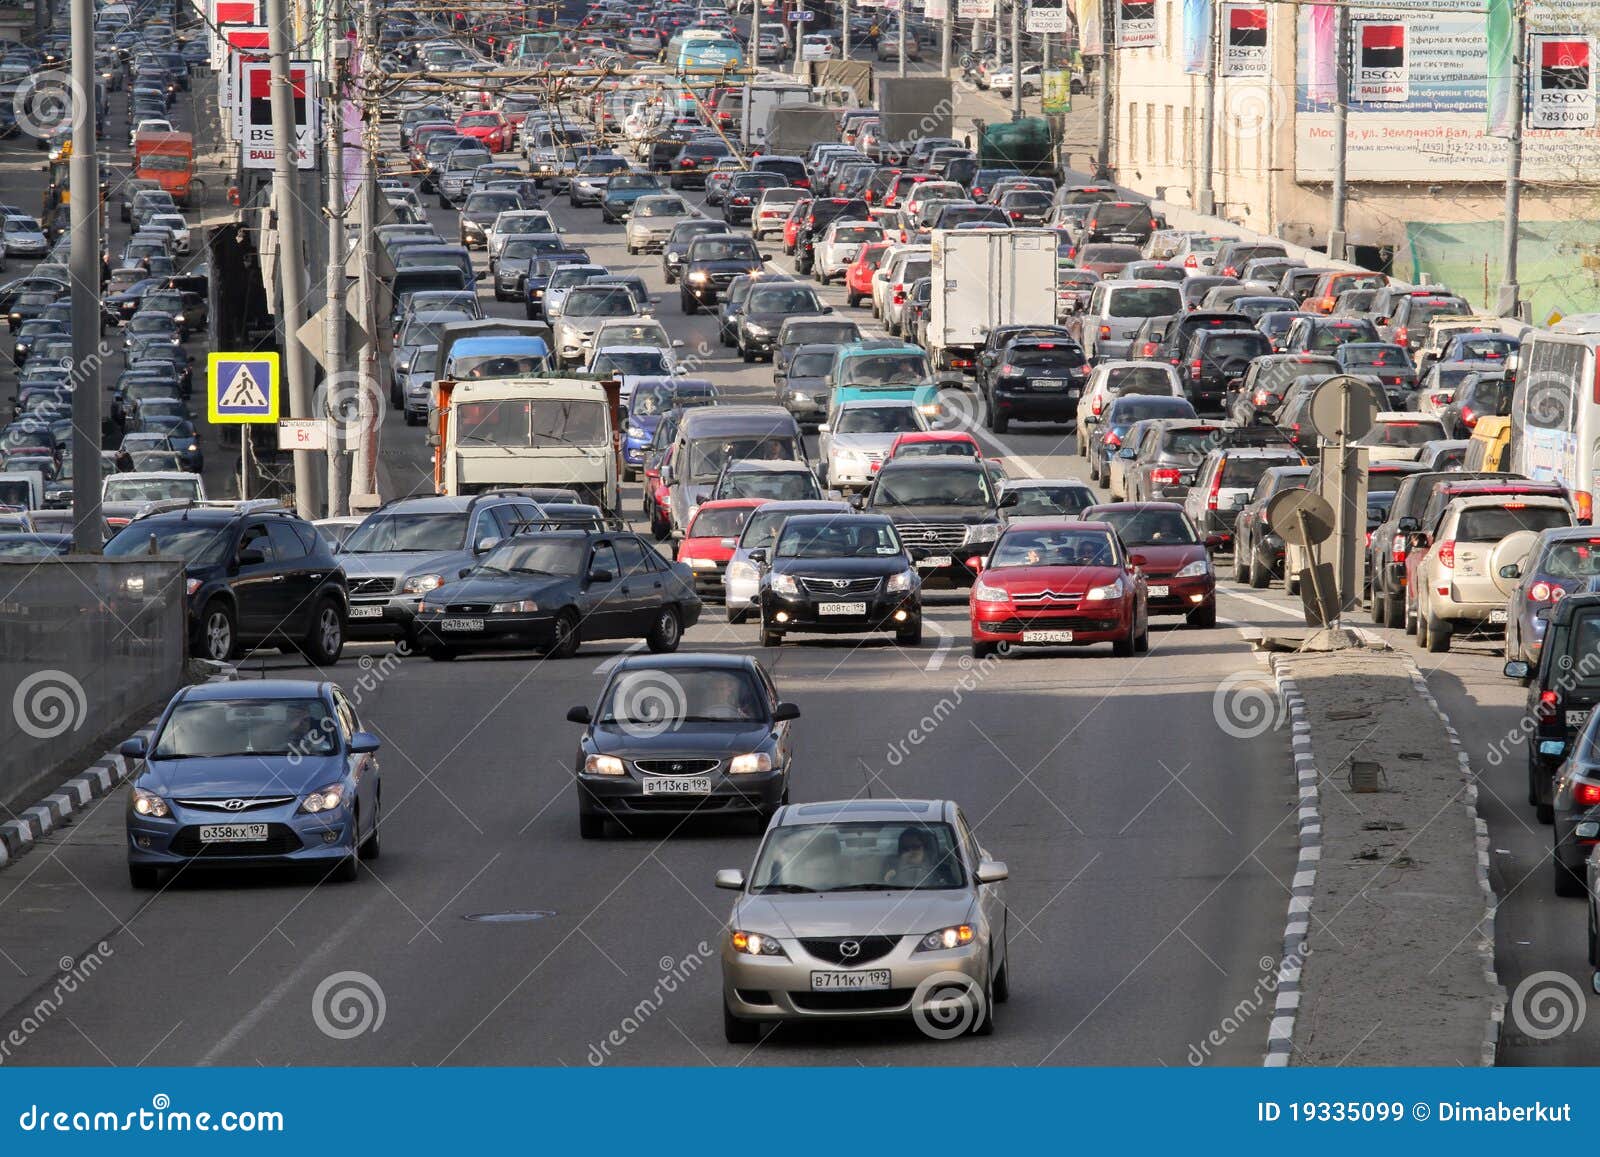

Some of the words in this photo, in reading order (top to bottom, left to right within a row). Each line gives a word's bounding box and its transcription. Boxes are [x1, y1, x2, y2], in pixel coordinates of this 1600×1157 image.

[1121, 22, 1155, 30] BSGV
[1229, 49, 1267, 57] BSGV
[1361, 70, 1403, 79] BSGV
[1361, 86, 1380, 94] ВАШ
[1381, 86, 1404, 94] БАНК
[1541, 93, 1589, 103] BSGV
[1542, 112, 1560, 121] 783
[1562, 112, 1575, 121] 00
[1576, 112, 1590, 121] 00
[250, 129, 307, 141] BSV
[1309, 127, 1358, 139] Моса,
[1361, 128, 1378, 139] ул.
[1383, 126, 1444, 138] Земляной
[1446, 127, 1471, 139] Вал,
[648, 780, 689, 791] В113КВ
[691, 779, 708, 788] 199
[203, 826, 247, 838] О358КХ
[249, 825, 265, 834] 197
[815, 974, 865, 986] В711КУ
[868, 971, 887, 982] 199
